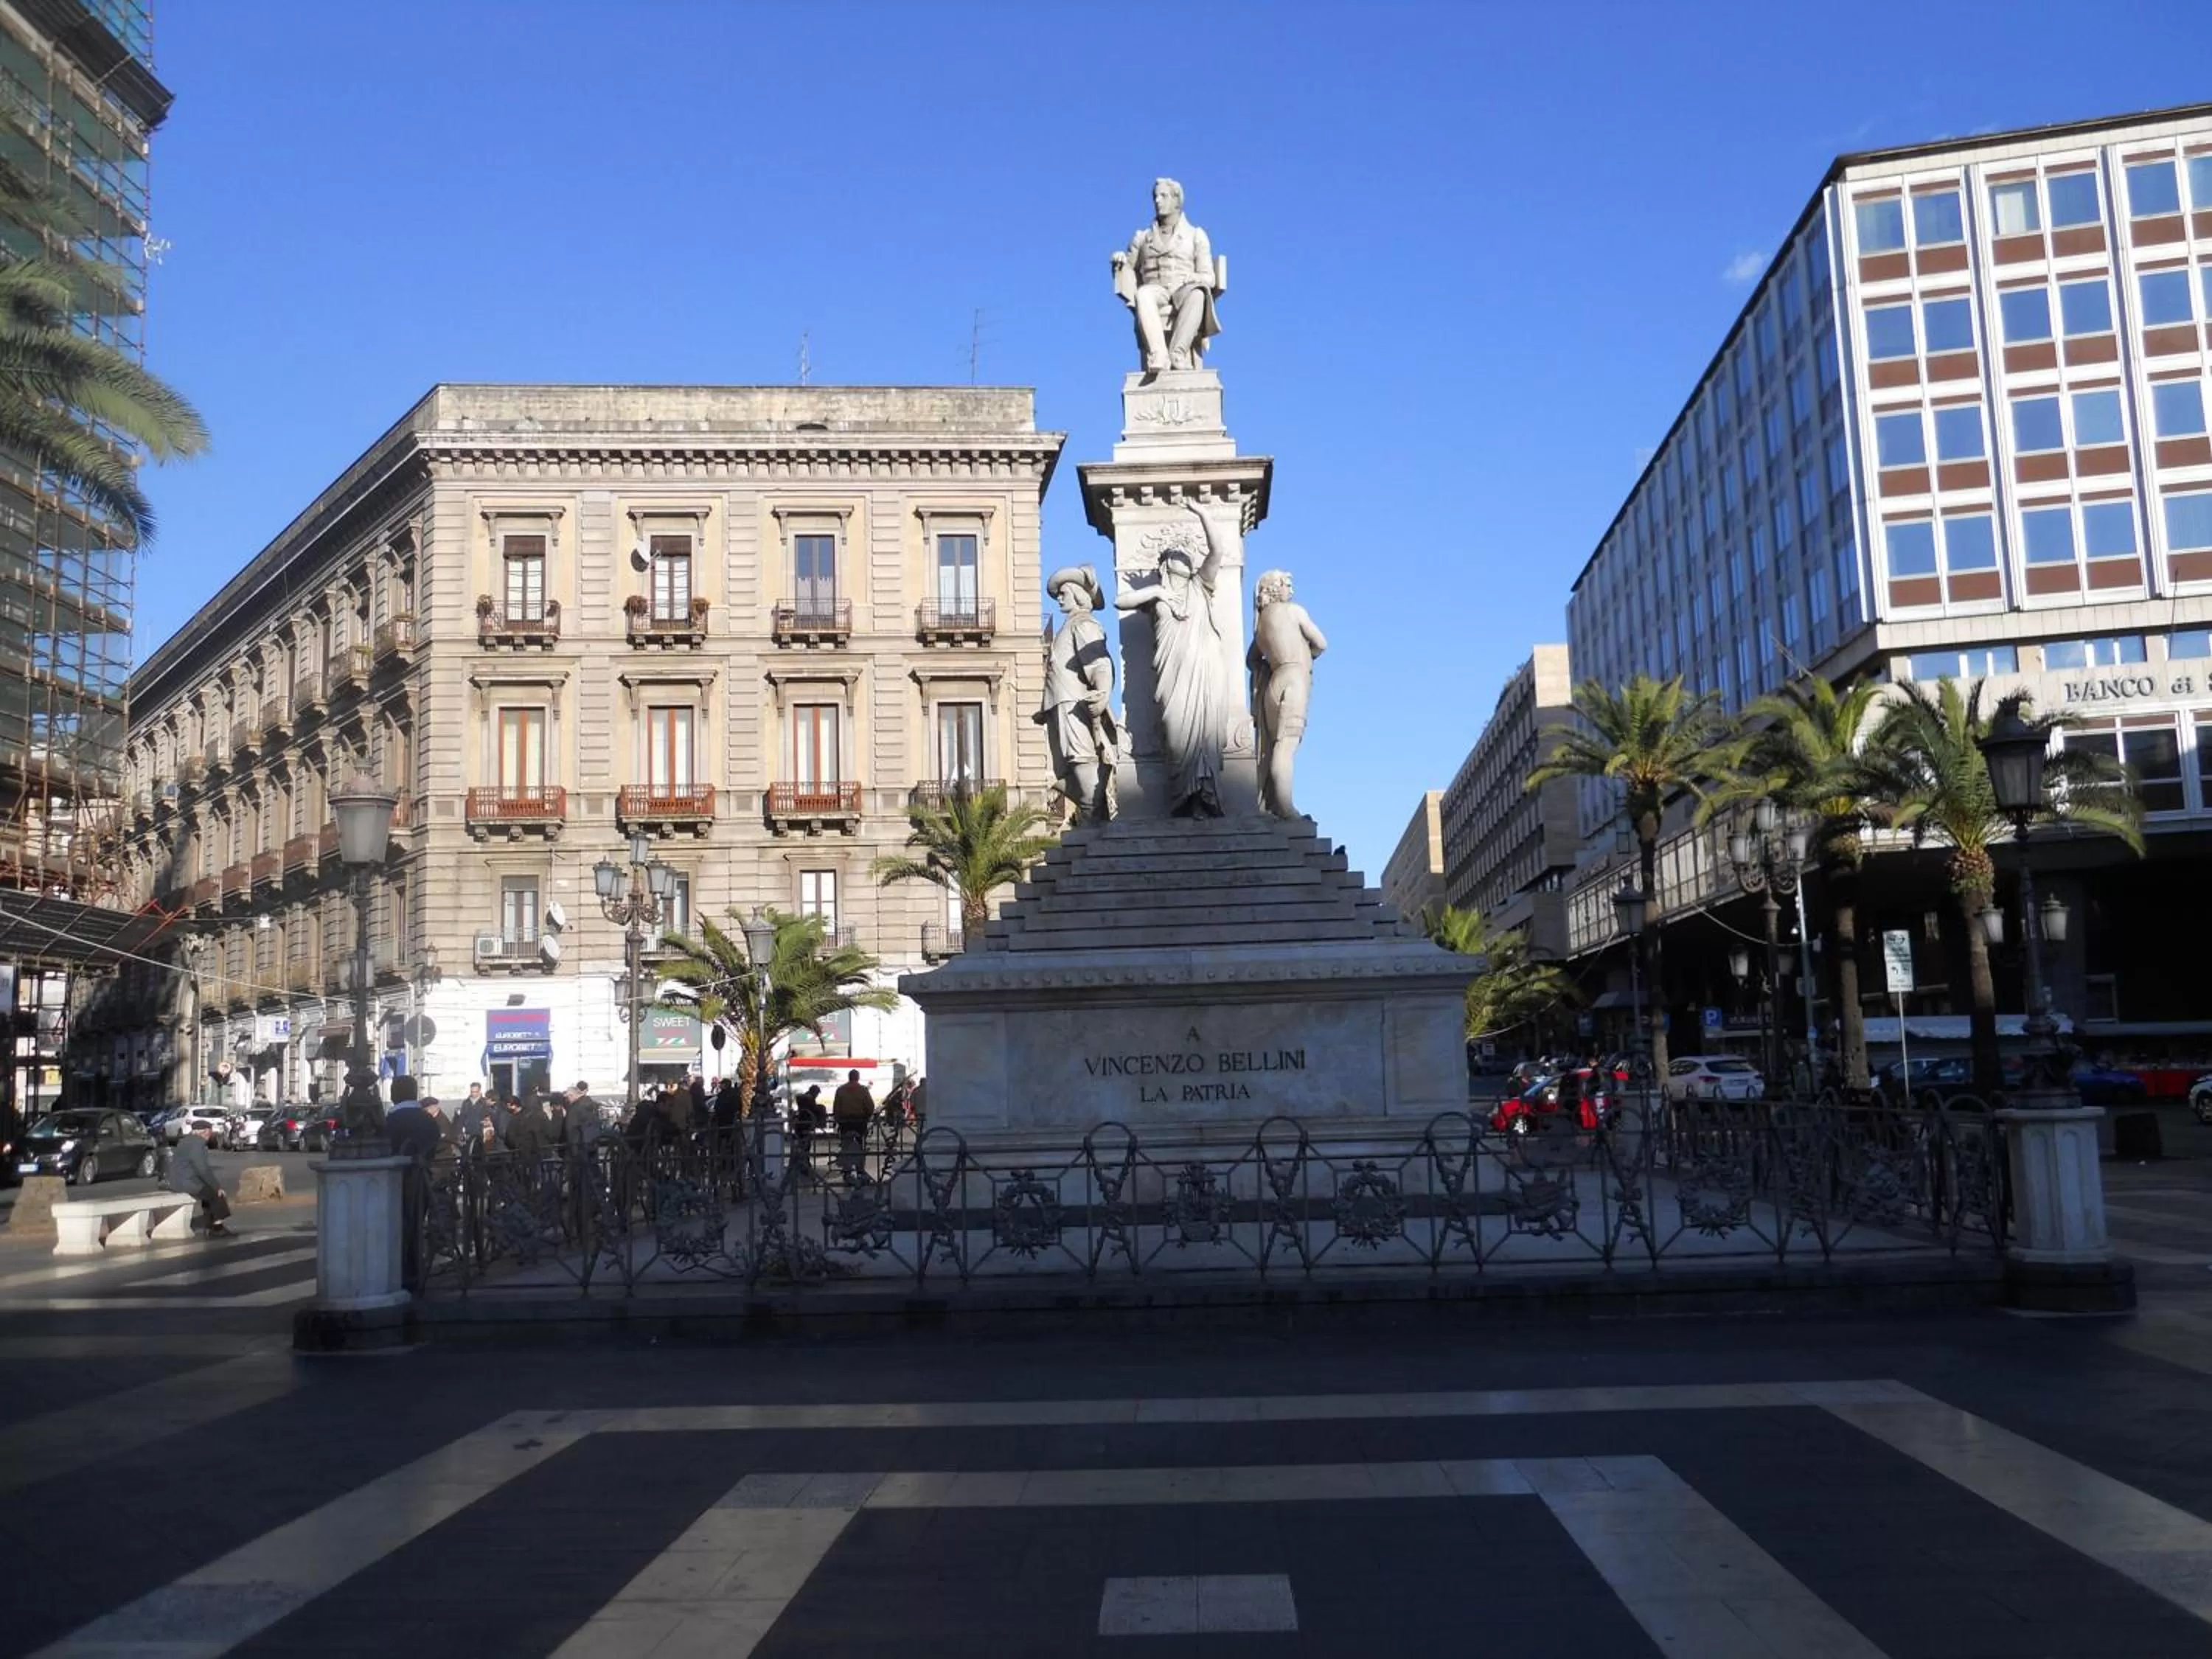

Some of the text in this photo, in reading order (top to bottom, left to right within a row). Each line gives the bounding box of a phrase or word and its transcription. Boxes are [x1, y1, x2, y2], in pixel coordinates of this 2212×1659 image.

[2065, 676, 2154, 703] BANCO
[2171, 676, 2194, 695] di
[653, 1018, 691, 1027] SWEET
[1705, 1009, 1717, 1024] P
[1186, 1026, 1200, 1042] A
[1085, 1050, 1306, 1077] VINCENZO BELLINI
[1140, 1084, 1251, 1102] LA PATRIA
